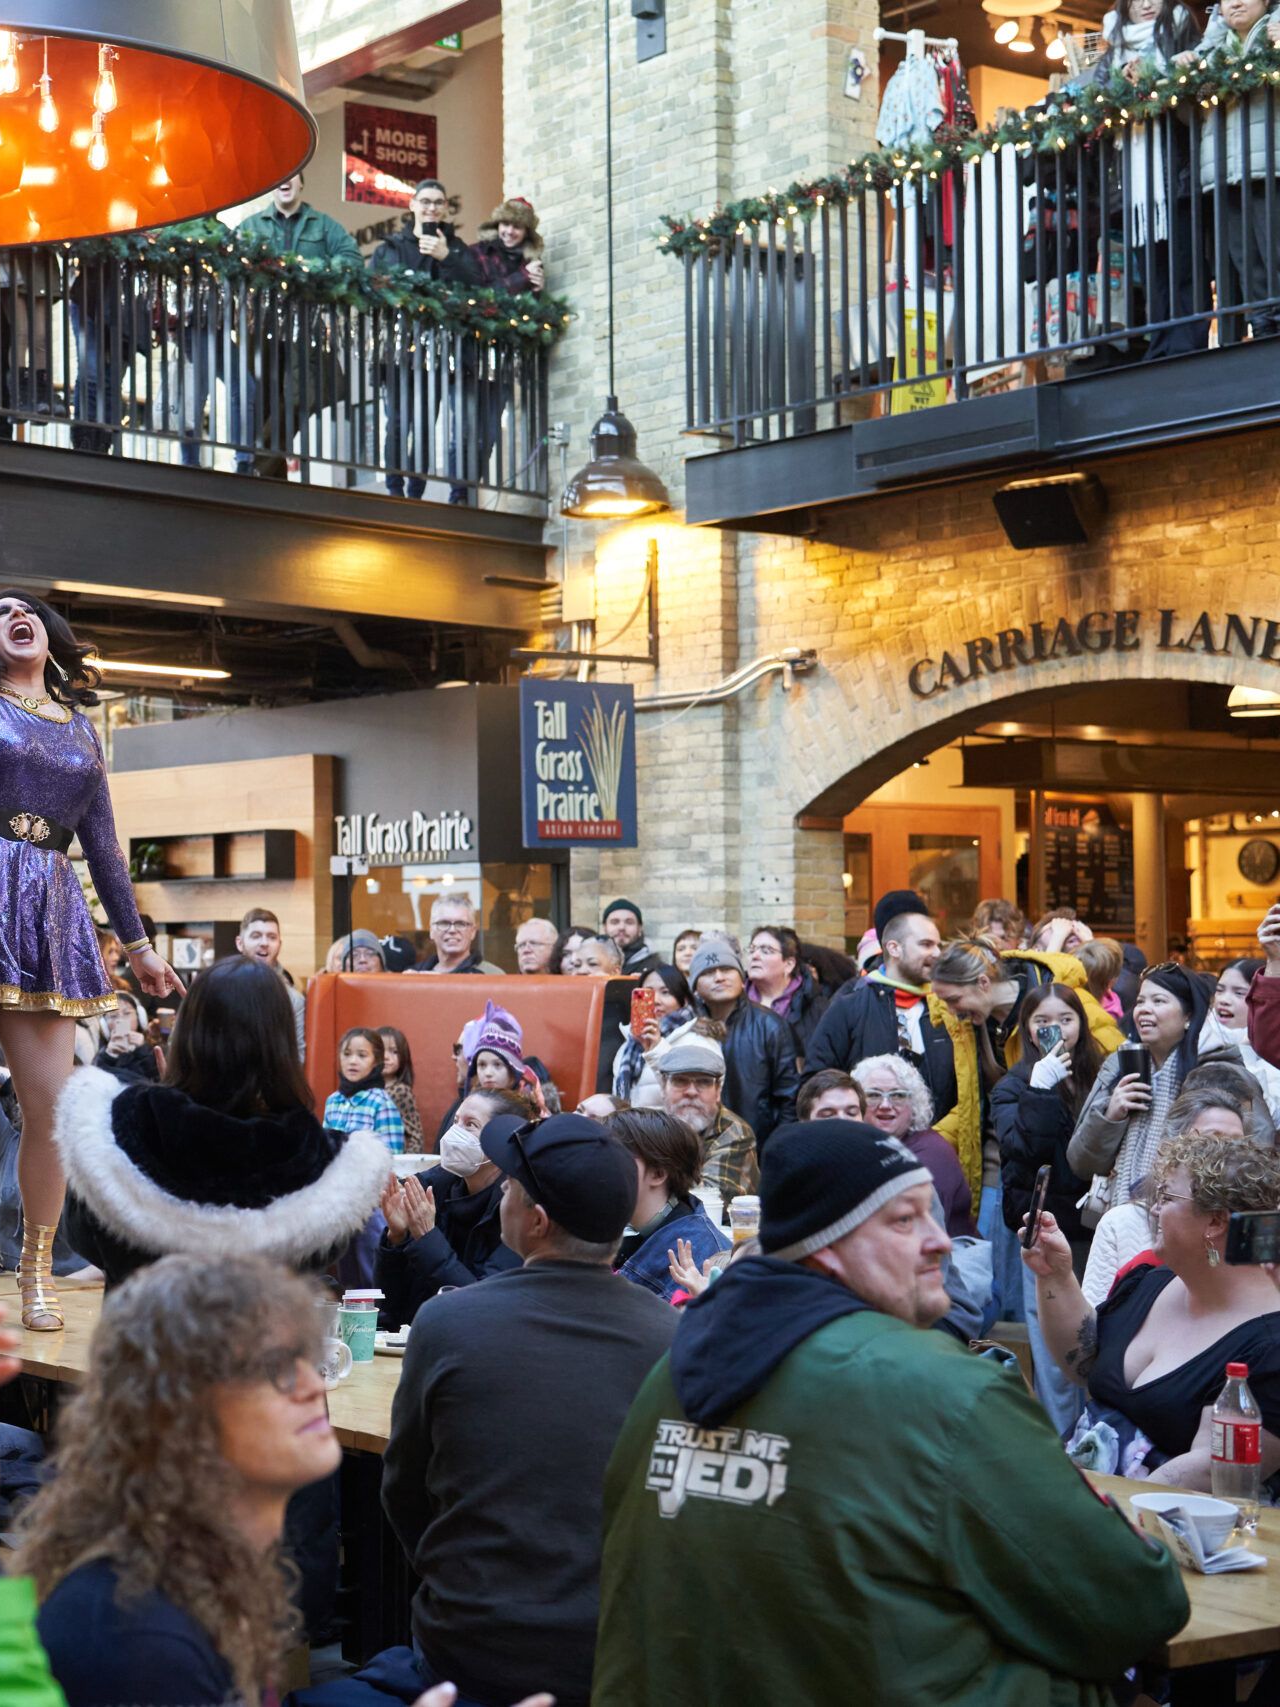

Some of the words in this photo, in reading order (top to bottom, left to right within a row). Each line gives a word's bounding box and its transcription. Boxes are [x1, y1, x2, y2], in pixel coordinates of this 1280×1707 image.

[375, 127, 428, 150] MORE
[375, 146, 429, 168] SHOPS
[908, 609, 1141, 697] CARRIAGE
[534, 700, 567, 739] Tall
[535, 741, 583, 782] Grass
[536, 782, 600, 822] Prairie
[334, 814, 362, 856] Tall
[366, 812, 409, 855] Grass
[412, 809, 471, 851] Prairie
[577, 824, 618, 836] COMPANY
[657, 1422, 738, 1452] TRUST
[744, 1434, 791, 1462] ME
[658, 1447, 789, 1519] JEDI
